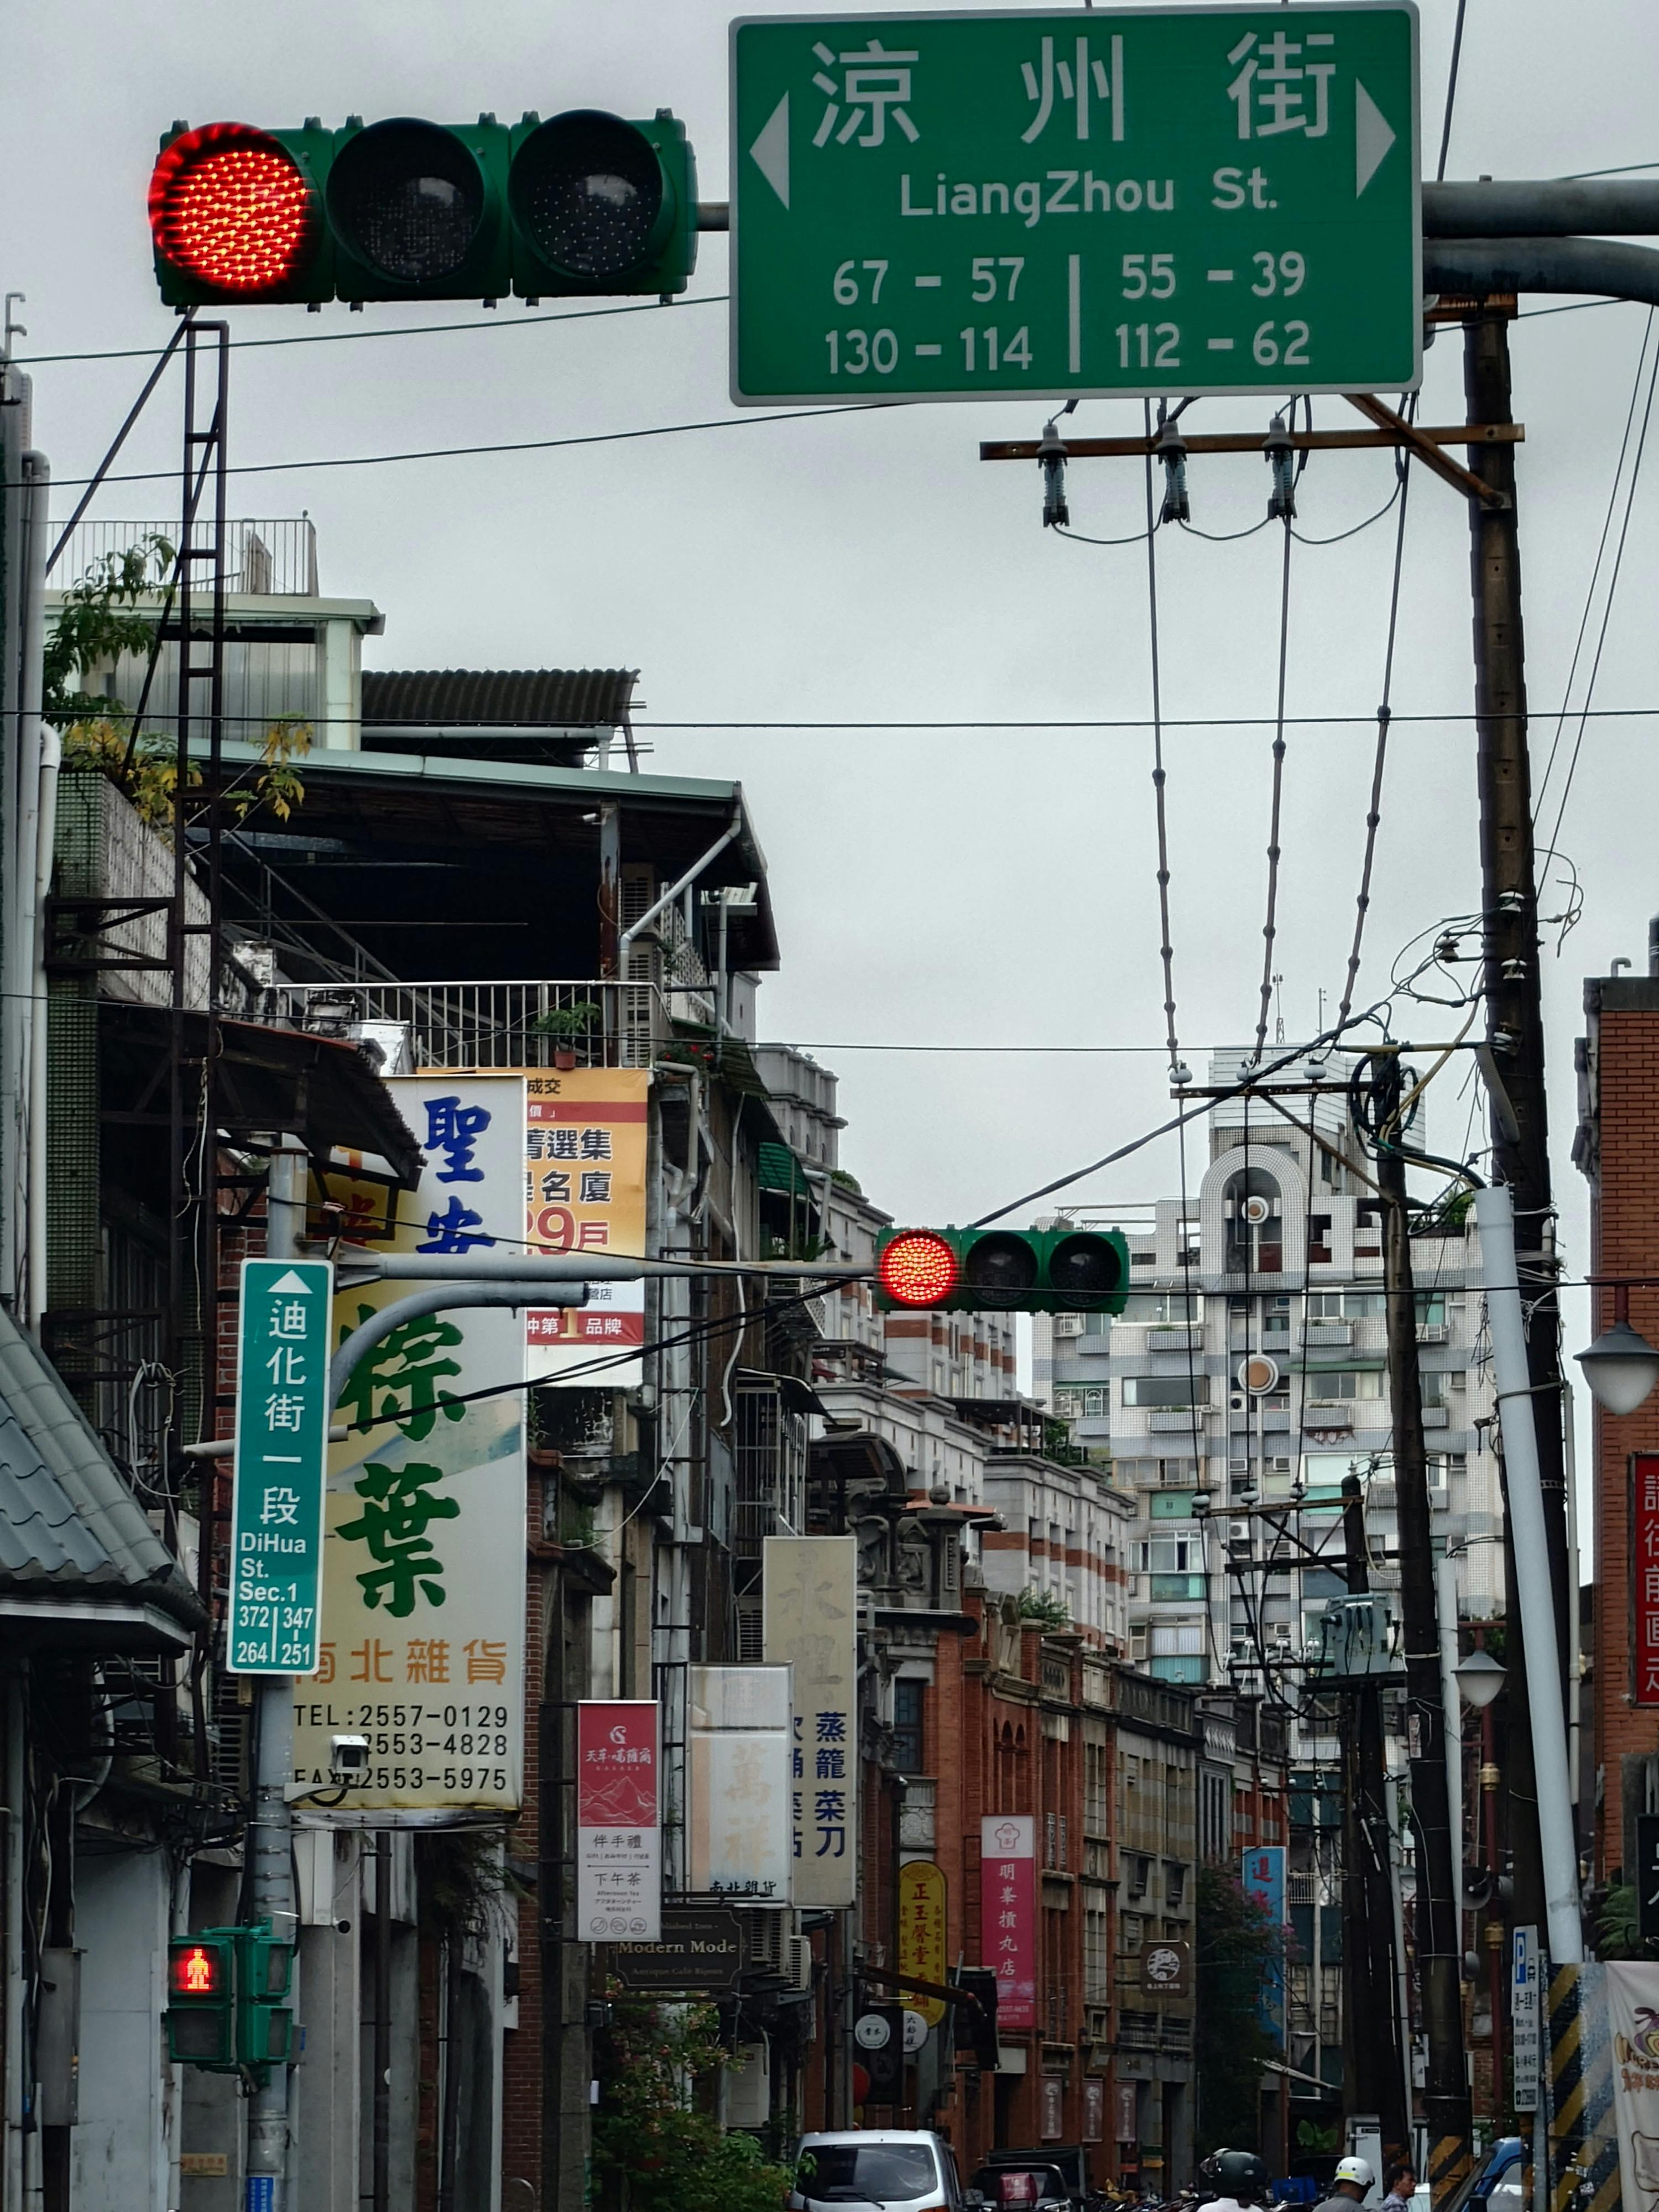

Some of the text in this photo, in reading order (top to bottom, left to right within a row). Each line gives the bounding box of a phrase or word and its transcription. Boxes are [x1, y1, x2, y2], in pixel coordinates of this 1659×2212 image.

[811, 32, 1336, 148] 涼州街
[901, 167, 1279, 228] LiangZhou St.
[833, 259, 889, 306] 67
[971, 257, 1025, 302] 57
[1121, 254, 1176, 299] 55
[1251, 251, 1307, 297] 39
[826, 330, 899, 375] 130
[961, 326, 1032, 372] 114
[1116, 323, 1181, 369] 112
[1252, 320, 1310, 366] 62
[260, 1300, 308, 1525] 迪化街一段
[241, 1531, 306, 1554] DiHua
[241, 1557, 269, 1579] St.
[239, 1580, 297, 1603] Sec.1
[239, 1605, 269, 1629] 372
[283, 1606, 314, 1630] 347
[237, 1641, 268, 1665] 264
[281, 1642, 311, 1666] 251
[294, 1705, 508, 1728] TEL:2557-0129
[294, 1768, 507, 1790] FAX2553-5975
[815, 1712, 847, 1858] 蒸籠菜刀
[593, 1834, 642, 1848] 伴手禮
[594, 1872, 641, 1886] 下午茶
[619, 1939, 737, 1953] Modern Mode
